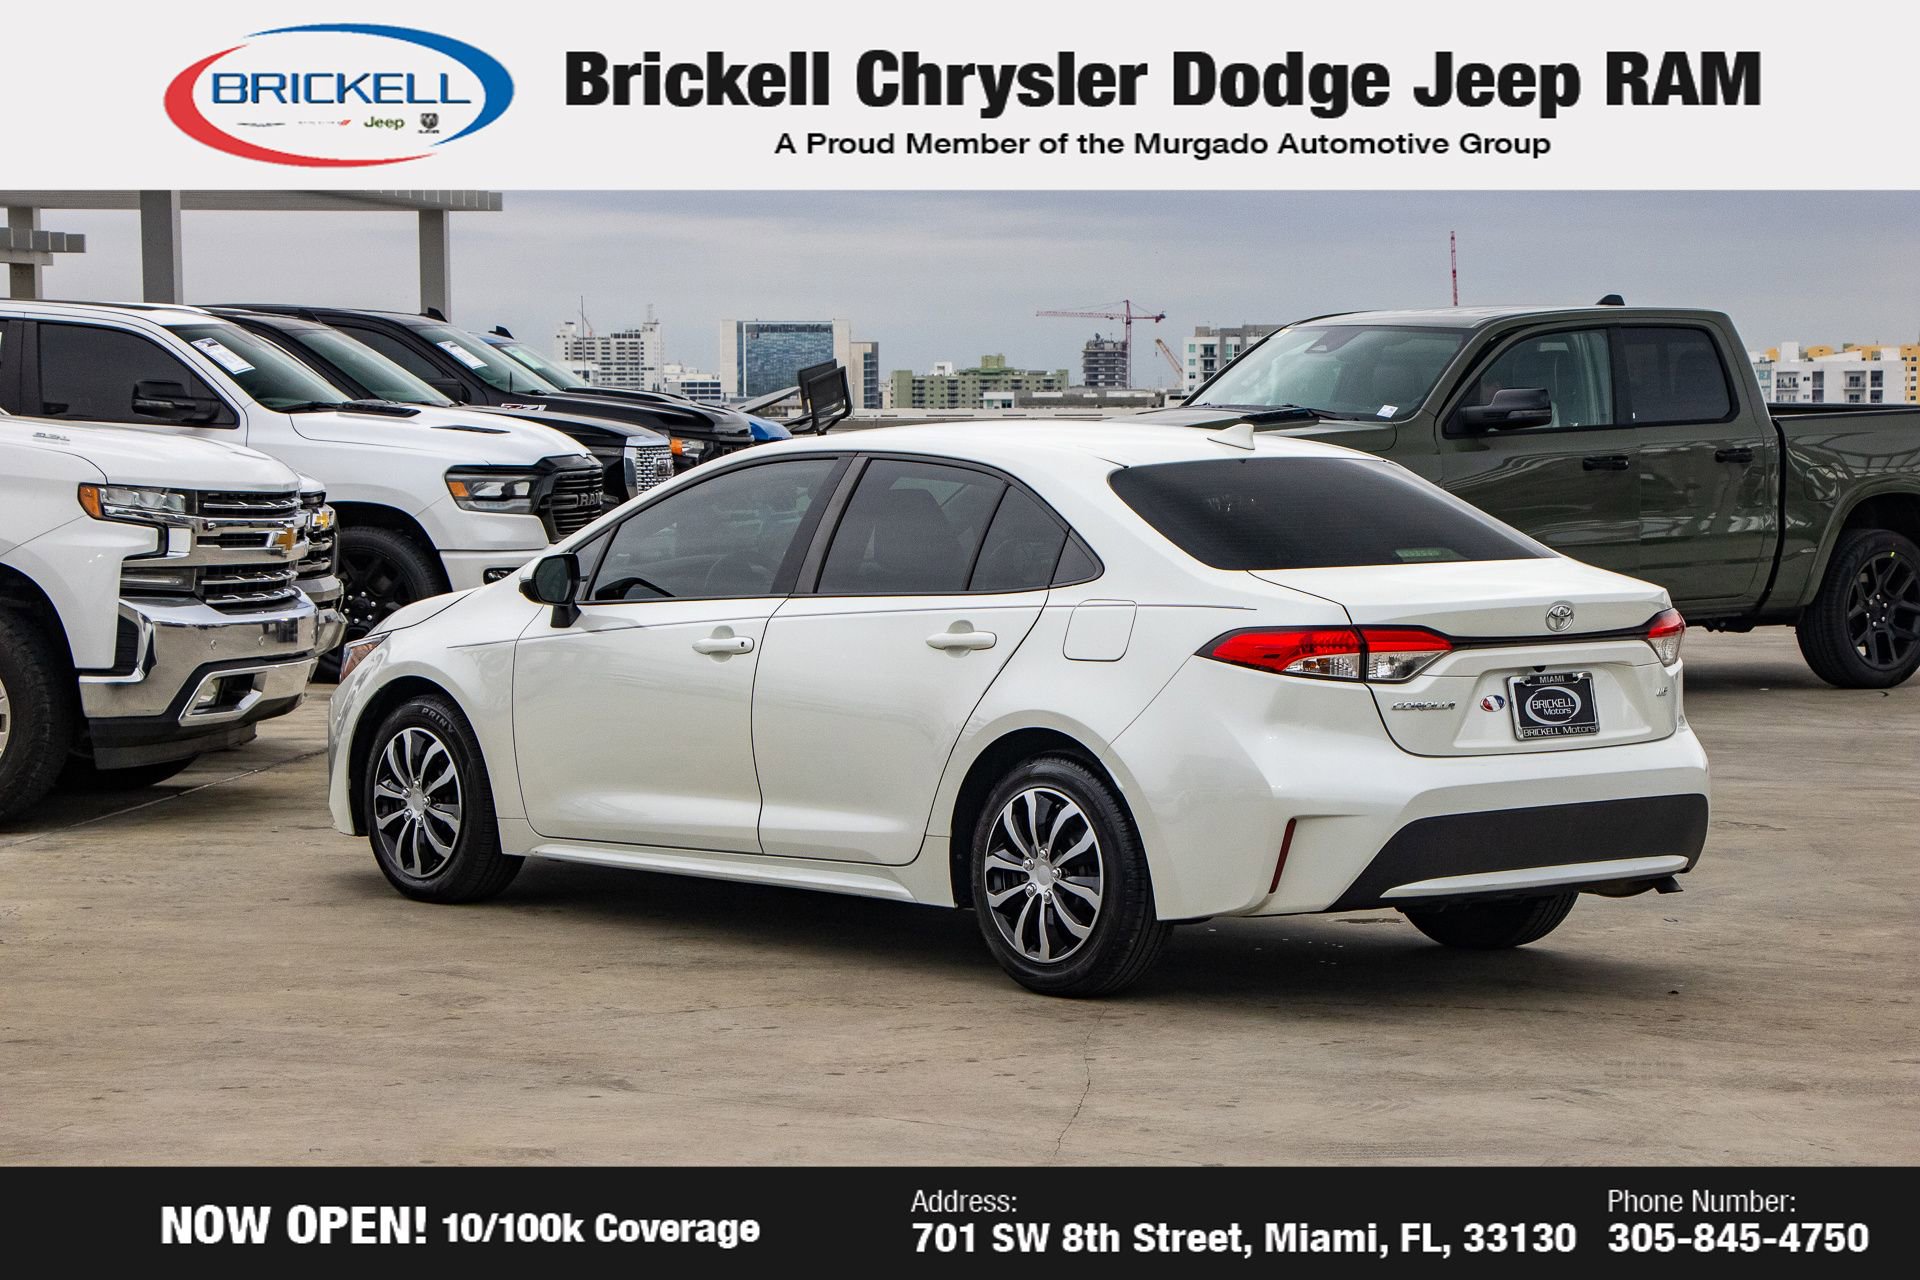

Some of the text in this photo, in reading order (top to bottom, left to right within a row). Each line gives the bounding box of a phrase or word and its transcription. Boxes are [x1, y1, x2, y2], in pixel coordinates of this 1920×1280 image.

[1540, 675, 1564, 683] MIAMI
[1532, 698, 1574, 710] BRICKELL
[1543, 707, 1572, 716] Motors
[1523, 725, 1596, 737] BRICKELL Motors
